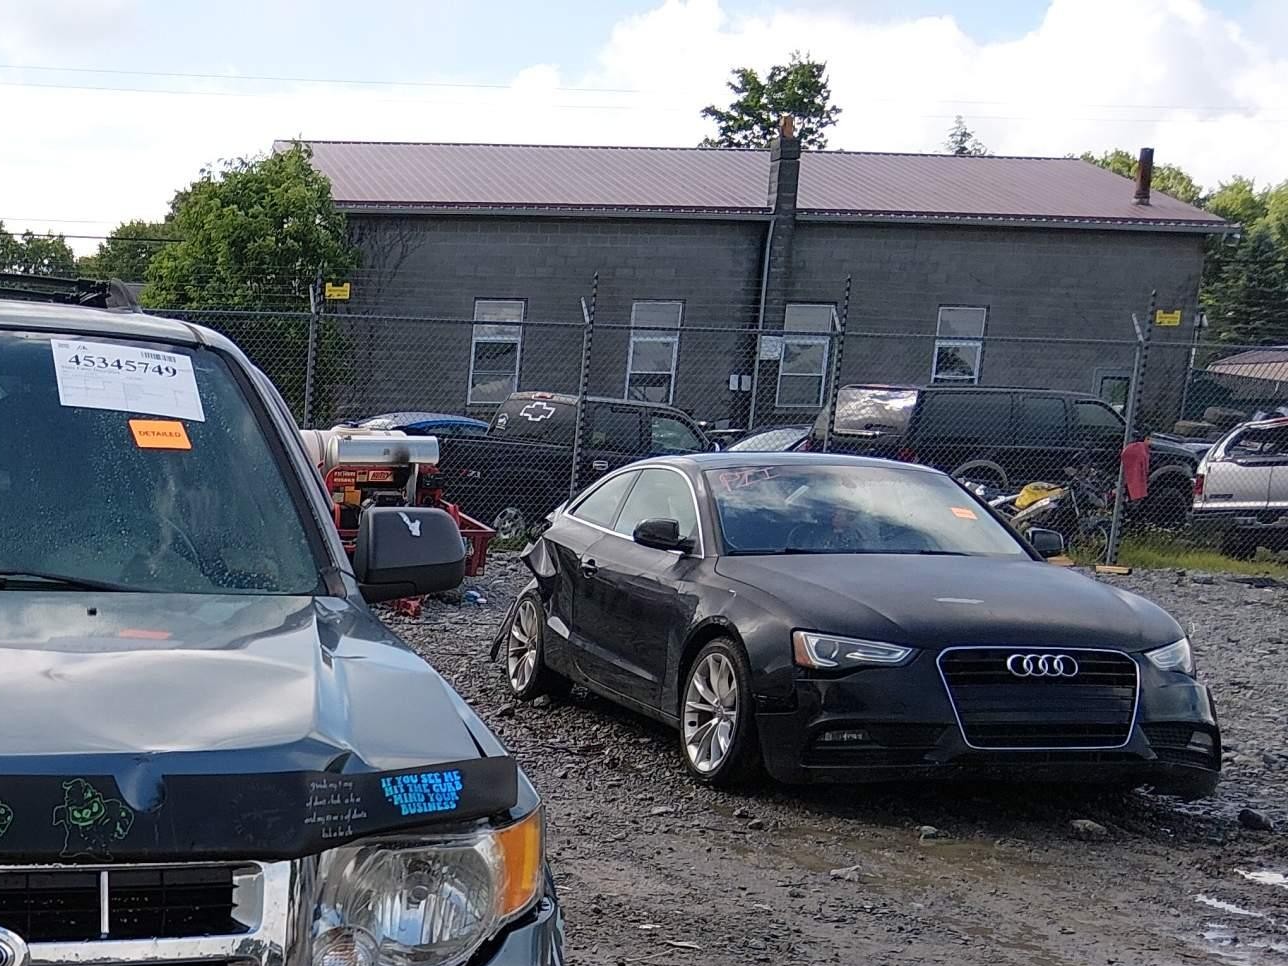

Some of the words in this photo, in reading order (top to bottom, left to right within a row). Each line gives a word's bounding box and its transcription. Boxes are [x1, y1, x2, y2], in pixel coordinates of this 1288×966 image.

[68, 354, 178, 378] 45345749
[138, 430, 182, 438] DETAILED
[380, 777, 393, 788] IF
[395, 775, 418, 785] YOU
[420, 772, 442, 784] SEE
[443, 770, 461, 781] ME
[384, 784, 405, 797] HIT
[406, 783, 431, 794] THE
[432, 780, 463, 792] CURB
[392, 792, 425, 806] MIND
[427, 791, 459, 802] YOUR
[400, 800, 457, 816] BUSINESS
